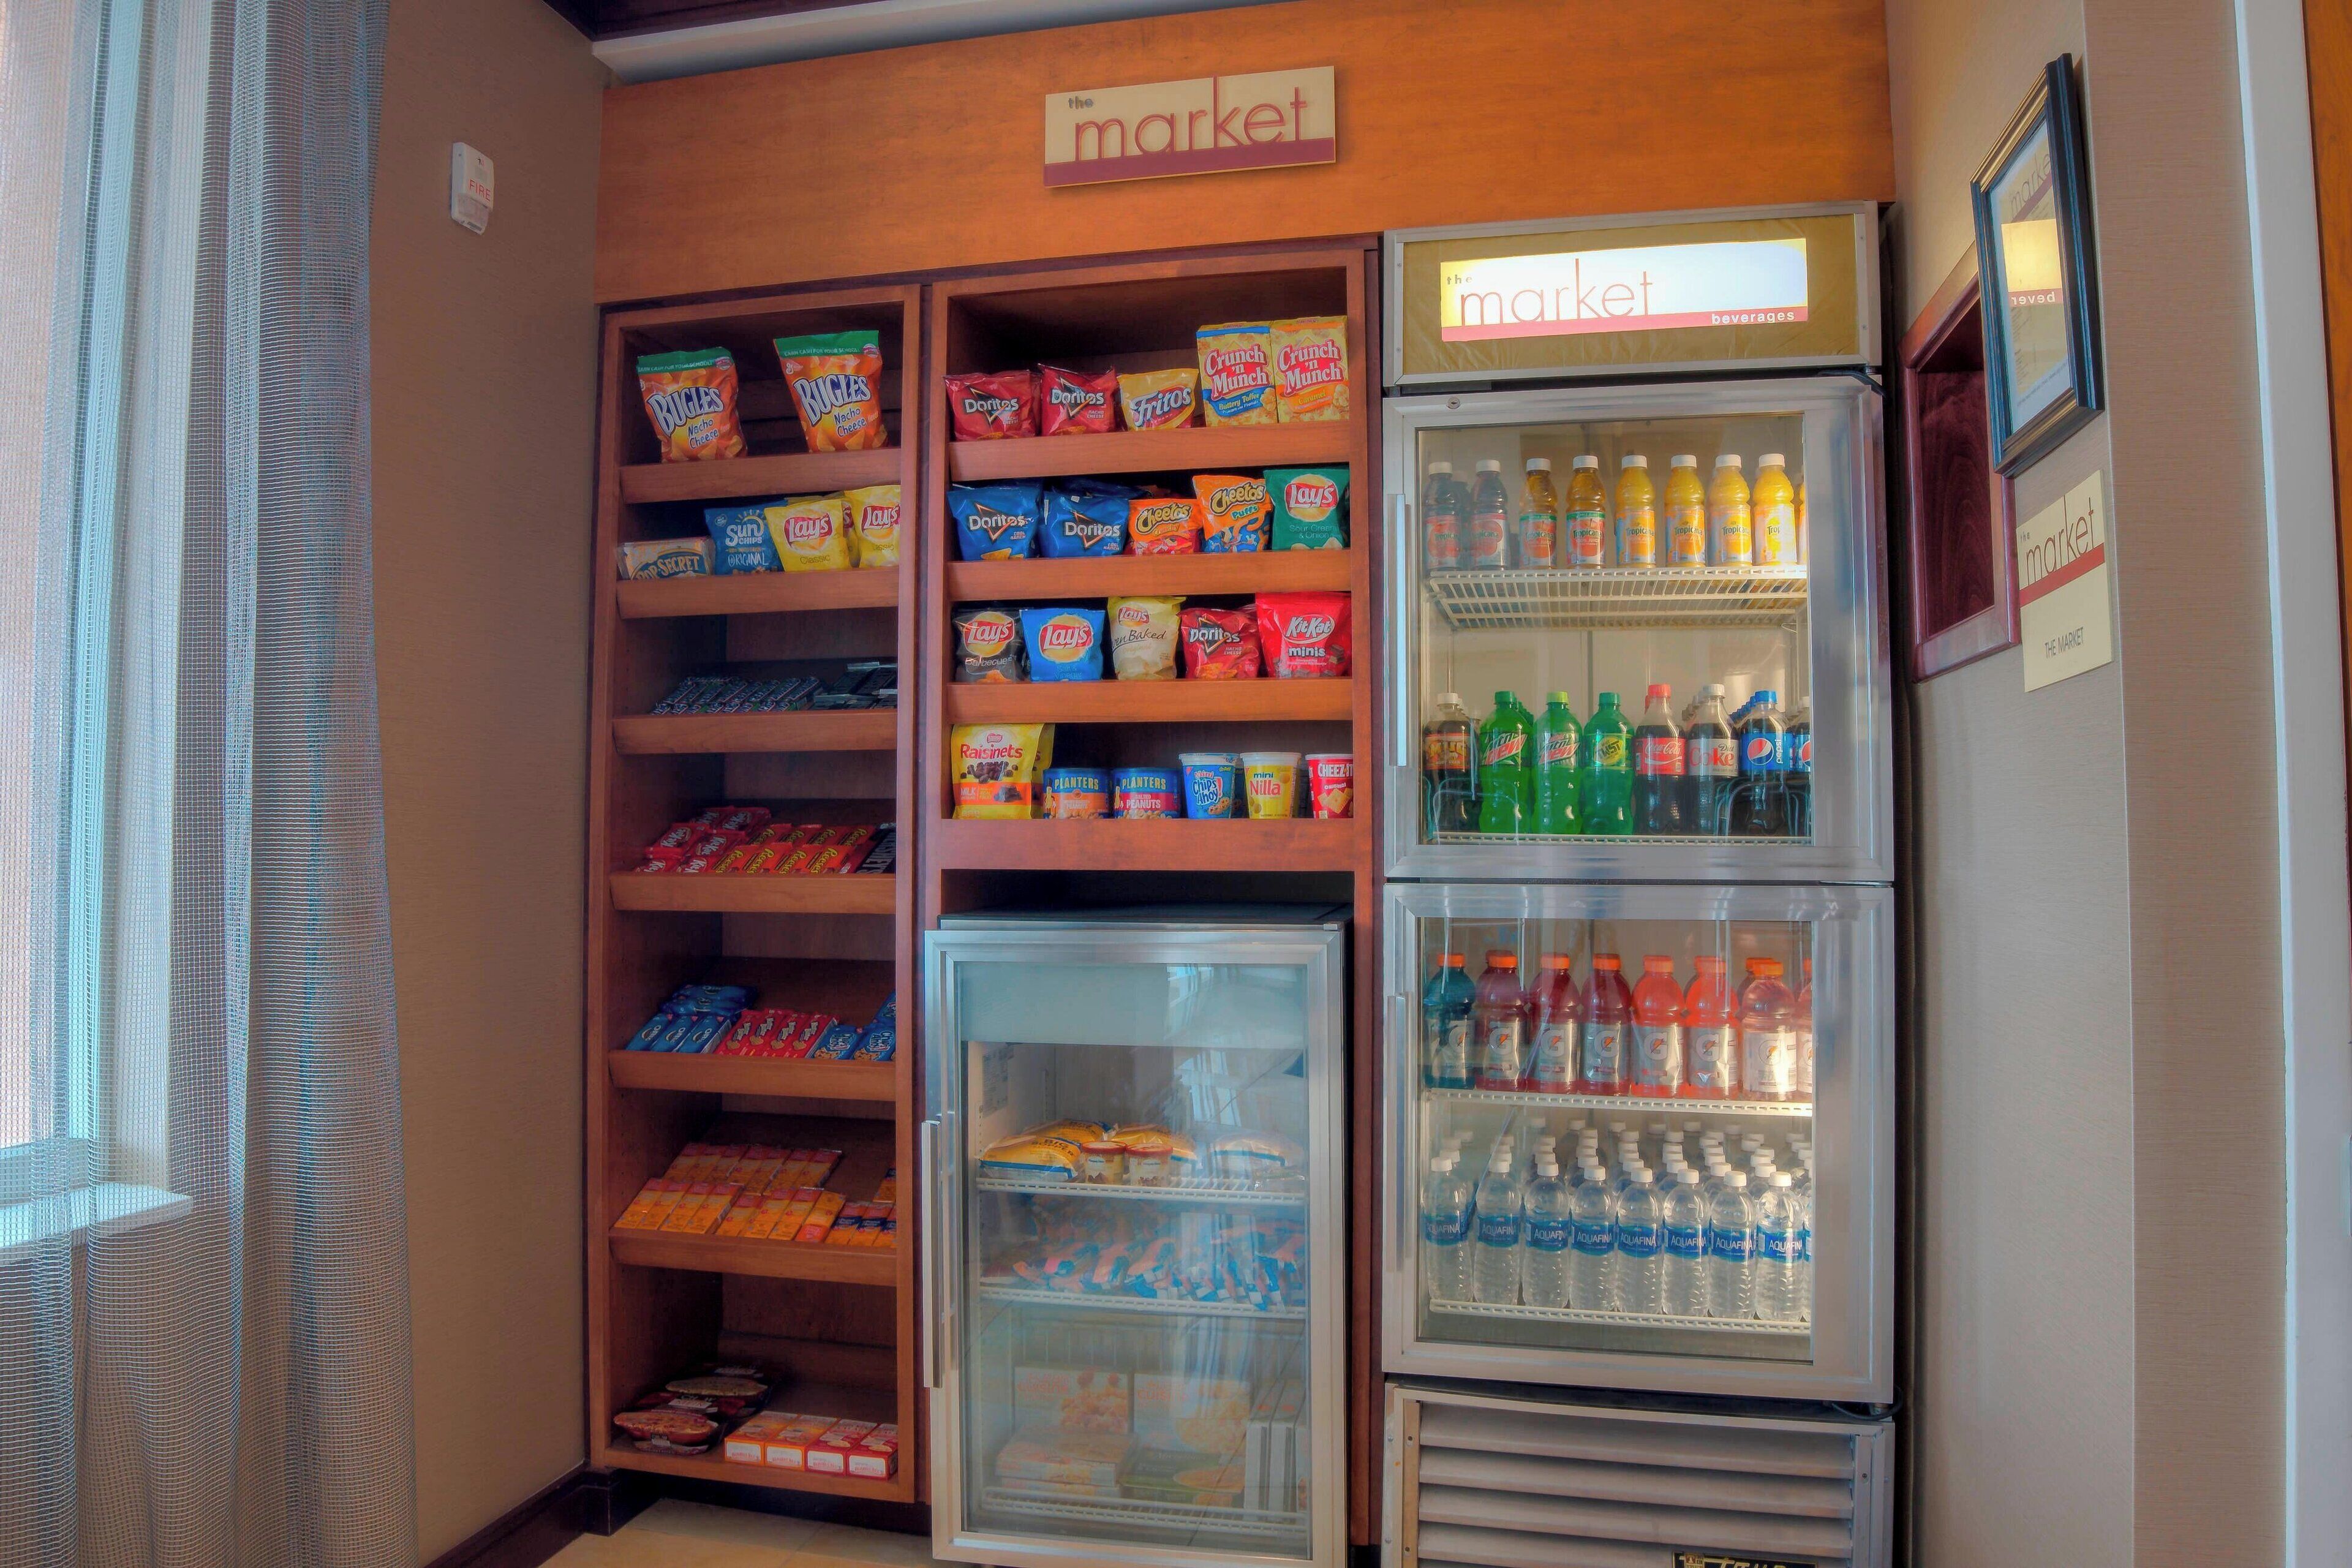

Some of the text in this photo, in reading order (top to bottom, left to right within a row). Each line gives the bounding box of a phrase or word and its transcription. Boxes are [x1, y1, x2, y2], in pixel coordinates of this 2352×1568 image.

[1068, 96, 1093, 110] the
[1075, 75, 1306, 162] market
[469, 179, 491, 202] FIRE
[2010, 153, 2051, 222] marke
[1447, 274, 1472, 285] the
[1461, 258, 1653, 326] market
[1712, 310, 1795, 325] beverages
[1206, 344, 1265, 375] Crunch
[1280, 339, 1340, 371] Crunch
[1212, 370, 1268, 398] Munch
[1285, 366, 1341, 394] Munch
[793, 374, 871, 427] BUGLES
[1051, 390, 1104, 404] Doritos
[1219, 400, 1240, 410] Buttery
[1298, 389, 1326, 405] Caramel
[647, 386, 724, 438] BUGLES
[964, 399, 1019, 413] Doritos
[1129, 386, 1193, 427] Fritos
[834, 407, 861, 424] Nacho
[688, 418, 713, 437] Nacho
[837, 418, 865, 437] Cheese
[690, 429, 718, 449] Cheese
[1210, 481, 1265, 515] Cheetos
[1289, 484, 1335, 509] Lay's
[864, 505, 899, 529] Lay's
[1136, 503, 1192, 535] Cheetos
[1231, 505, 1259, 520] Puffs
[790, 516, 829, 542] Lay's
[969, 515, 1025, 530] Doritos
[1065, 522, 1121, 537] Doritos
[1674, 526, 1703, 536] Tropicana
[725, 518, 764, 546] Sun
[1526, 530, 1555, 541] Tropicana
[1573, 528, 1604, 539] Tropicana
[1626, 526, 1654, 537] Tropicana
[2026, 495, 2094, 586] market
[657, 556, 700, 576] SECRET
[728, 552, 769, 567] ORIGINAL
[800, 555, 831, 565] Classic
[1119, 607, 1148, 622] Lay's
[968, 621, 1012, 644] Lay's
[1044, 625, 1089, 650] Lay's
[1129, 629, 1167, 646] Baked
[1189, 627, 1240, 643] Doritos
[2045, 627, 2084, 658] THE MARKET
[1288, 647, 1326, 657] minis
[960, 744, 1023, 760] Raisinets
[1645, 741, 1682, 755] Coca-Cola
[1689, 747, 1735, 766] Coke
[1718, 744, 1735, 752] Diet
[1774, 738, 1784, 764] pepsi
[960, 787, 976, 796] MILK
[1054, 777, 1099, 790] PLANTERS
[1122, 777, 1166, 790] PLANTERS
[1193, 778, 1217, 796] Chips
[1250, 780, 1281, 796] Nilla
[1126, 799, 1161, 809] PEANUTS
[1489, 1027, 1512, 1055] G
[1540, 1029, 1564, 1057] G
[1593, 1030, 1618, 1058] G
[1644, 1032, 1668, 1060] G
[1695, 1033, 1721, 1061] G
[1043, 1138, 1069, 1149] BIG
[1534, 1229, 1569, 1240] AQUAFINA
[1577, 1232, 1613, 1243] AQUAFINA
[1620, 1232, 1656, 1246] AQUAFINA
[1670, 1234, 1708, 1247] AQUAFINA
[1716, 1236, 1756, 1251] AQUAFINA
[1768, 1238, 1803, 1251] AQUAFINA
